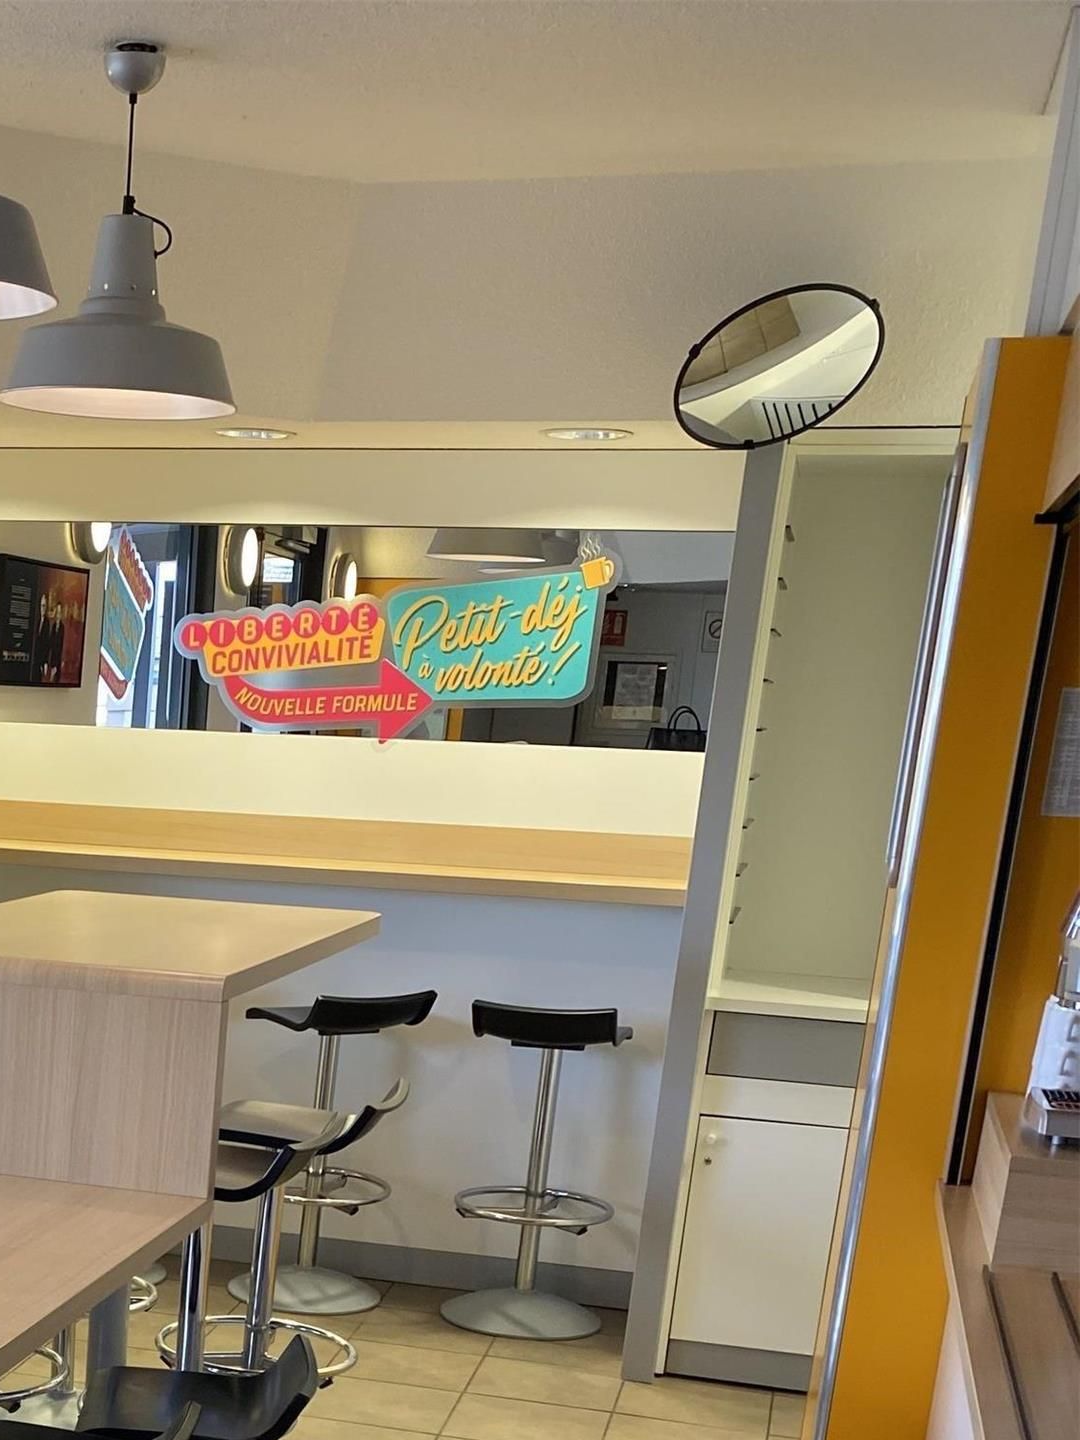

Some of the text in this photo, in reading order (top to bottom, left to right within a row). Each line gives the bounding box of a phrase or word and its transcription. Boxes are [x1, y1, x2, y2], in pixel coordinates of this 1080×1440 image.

[188, 605, 370, 647] LIBERTÉ
[393, 575, 589, 671] Petit-déj
[211, 632, 374, 675] CONVIVIALITÉ
[418, 654, 435, 680] à
[234, 686, 419, 717] NOUVELLE FORMULE
